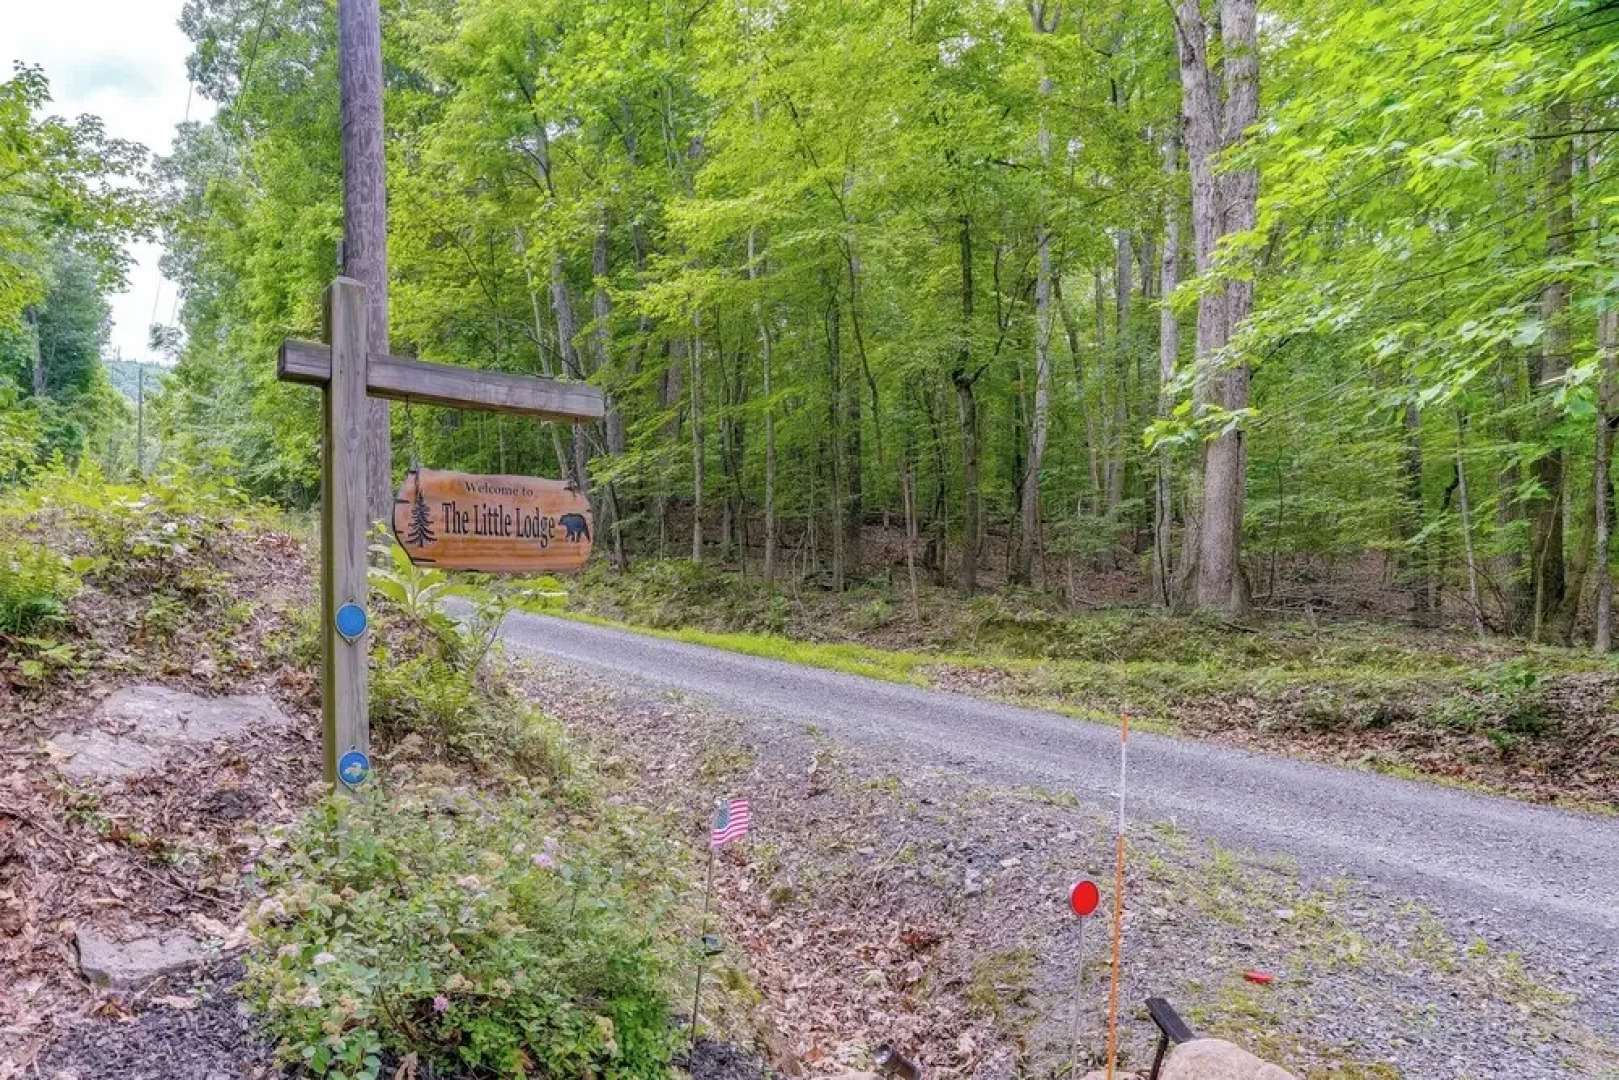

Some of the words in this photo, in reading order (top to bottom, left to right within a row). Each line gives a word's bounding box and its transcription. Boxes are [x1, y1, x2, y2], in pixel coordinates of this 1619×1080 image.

[465, 481, 519, 496] Welcome
[522, 487, 533, 497] to
[441, 500, 469, 534] The
[473, 503, 512, 537] Little
[515, 507, 556, 548] Lodge
